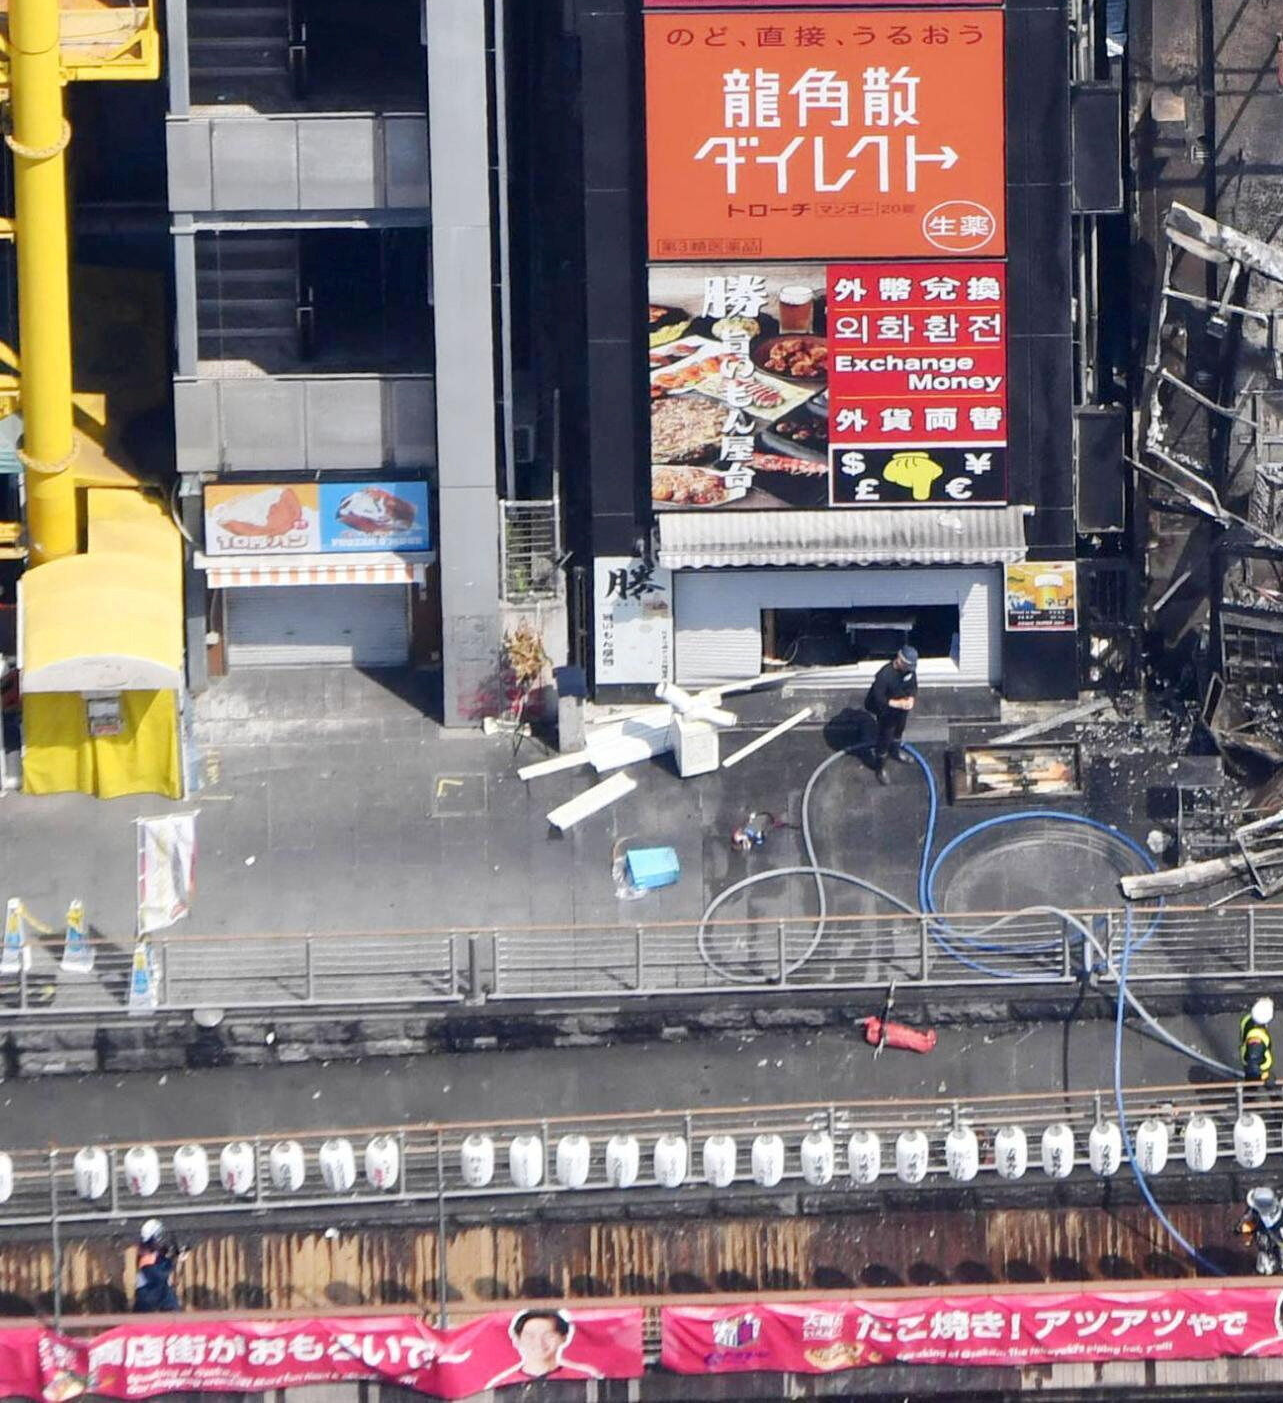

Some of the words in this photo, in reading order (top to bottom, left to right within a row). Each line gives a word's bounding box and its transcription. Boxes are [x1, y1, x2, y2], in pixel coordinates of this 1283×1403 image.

[667, 24, 983, 47] のど、直接、うるおう
[722, 66, 921, 129] 龍角散
[693, 134, 960, 195] ダイレクト
[727, 203, 811, 218] トローチ
[928, 215, 990, 237] 生薬
[835, 312, 1003, 345] 외화환전
[835, 355, 974, 374] Exchange
[908, 373, 1003, 393] Money
[836, 407, 1003, 433] 外貨両替
[841, 451, 866, 476] $
[964, 453, 992, 476] ¥
[855, 478, 881, 501] £
[945, 477, 972, 500] €
